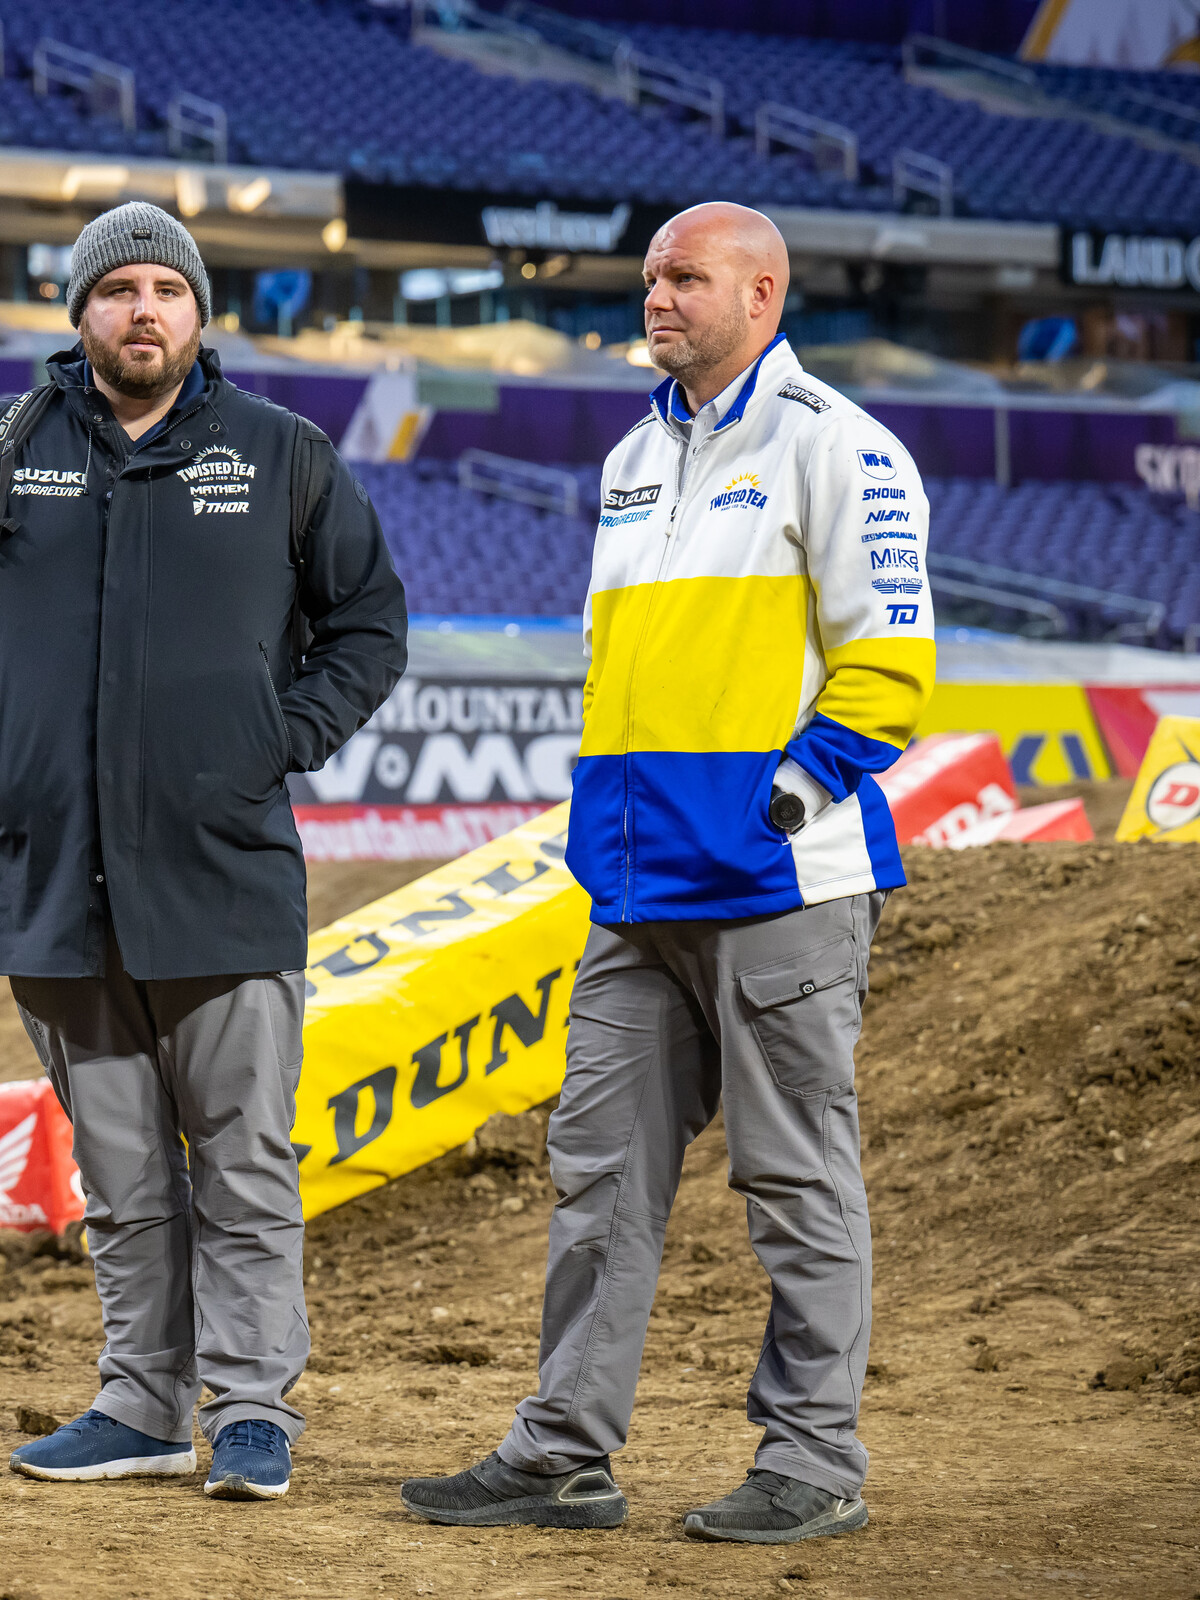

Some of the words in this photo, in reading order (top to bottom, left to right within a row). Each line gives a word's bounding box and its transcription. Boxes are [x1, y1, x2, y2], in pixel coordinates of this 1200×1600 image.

[780, 384, 831, 413] MAYHEM
[862, 453, 893, 468] WD-40
[13, 468, 87, 485] SUZUKI
[176, 462, 231, 482] TWISTED
[232, 461, 257, 479] TEA
[11, 484, 84, 497] PROGRESSIVE
[190, 484, 249, 496] MAYHEM
[604, 487, 659, 507] SUZUKI
[862, 488, 906, 501] SHOWA
[206, 502, 249, 514] THOR
[710, 489, 747, 511] TWISTED
[746, 488, 768, 510] TEA
[599, 510, 652, 528] PROGRESSIVE
[865, 510, 910, 524] NISSIN
[871, 578, 899, 586] MIDLAND
[305, 829, 568, 999] UNL
[327, 958, 582, 1167] DUN
